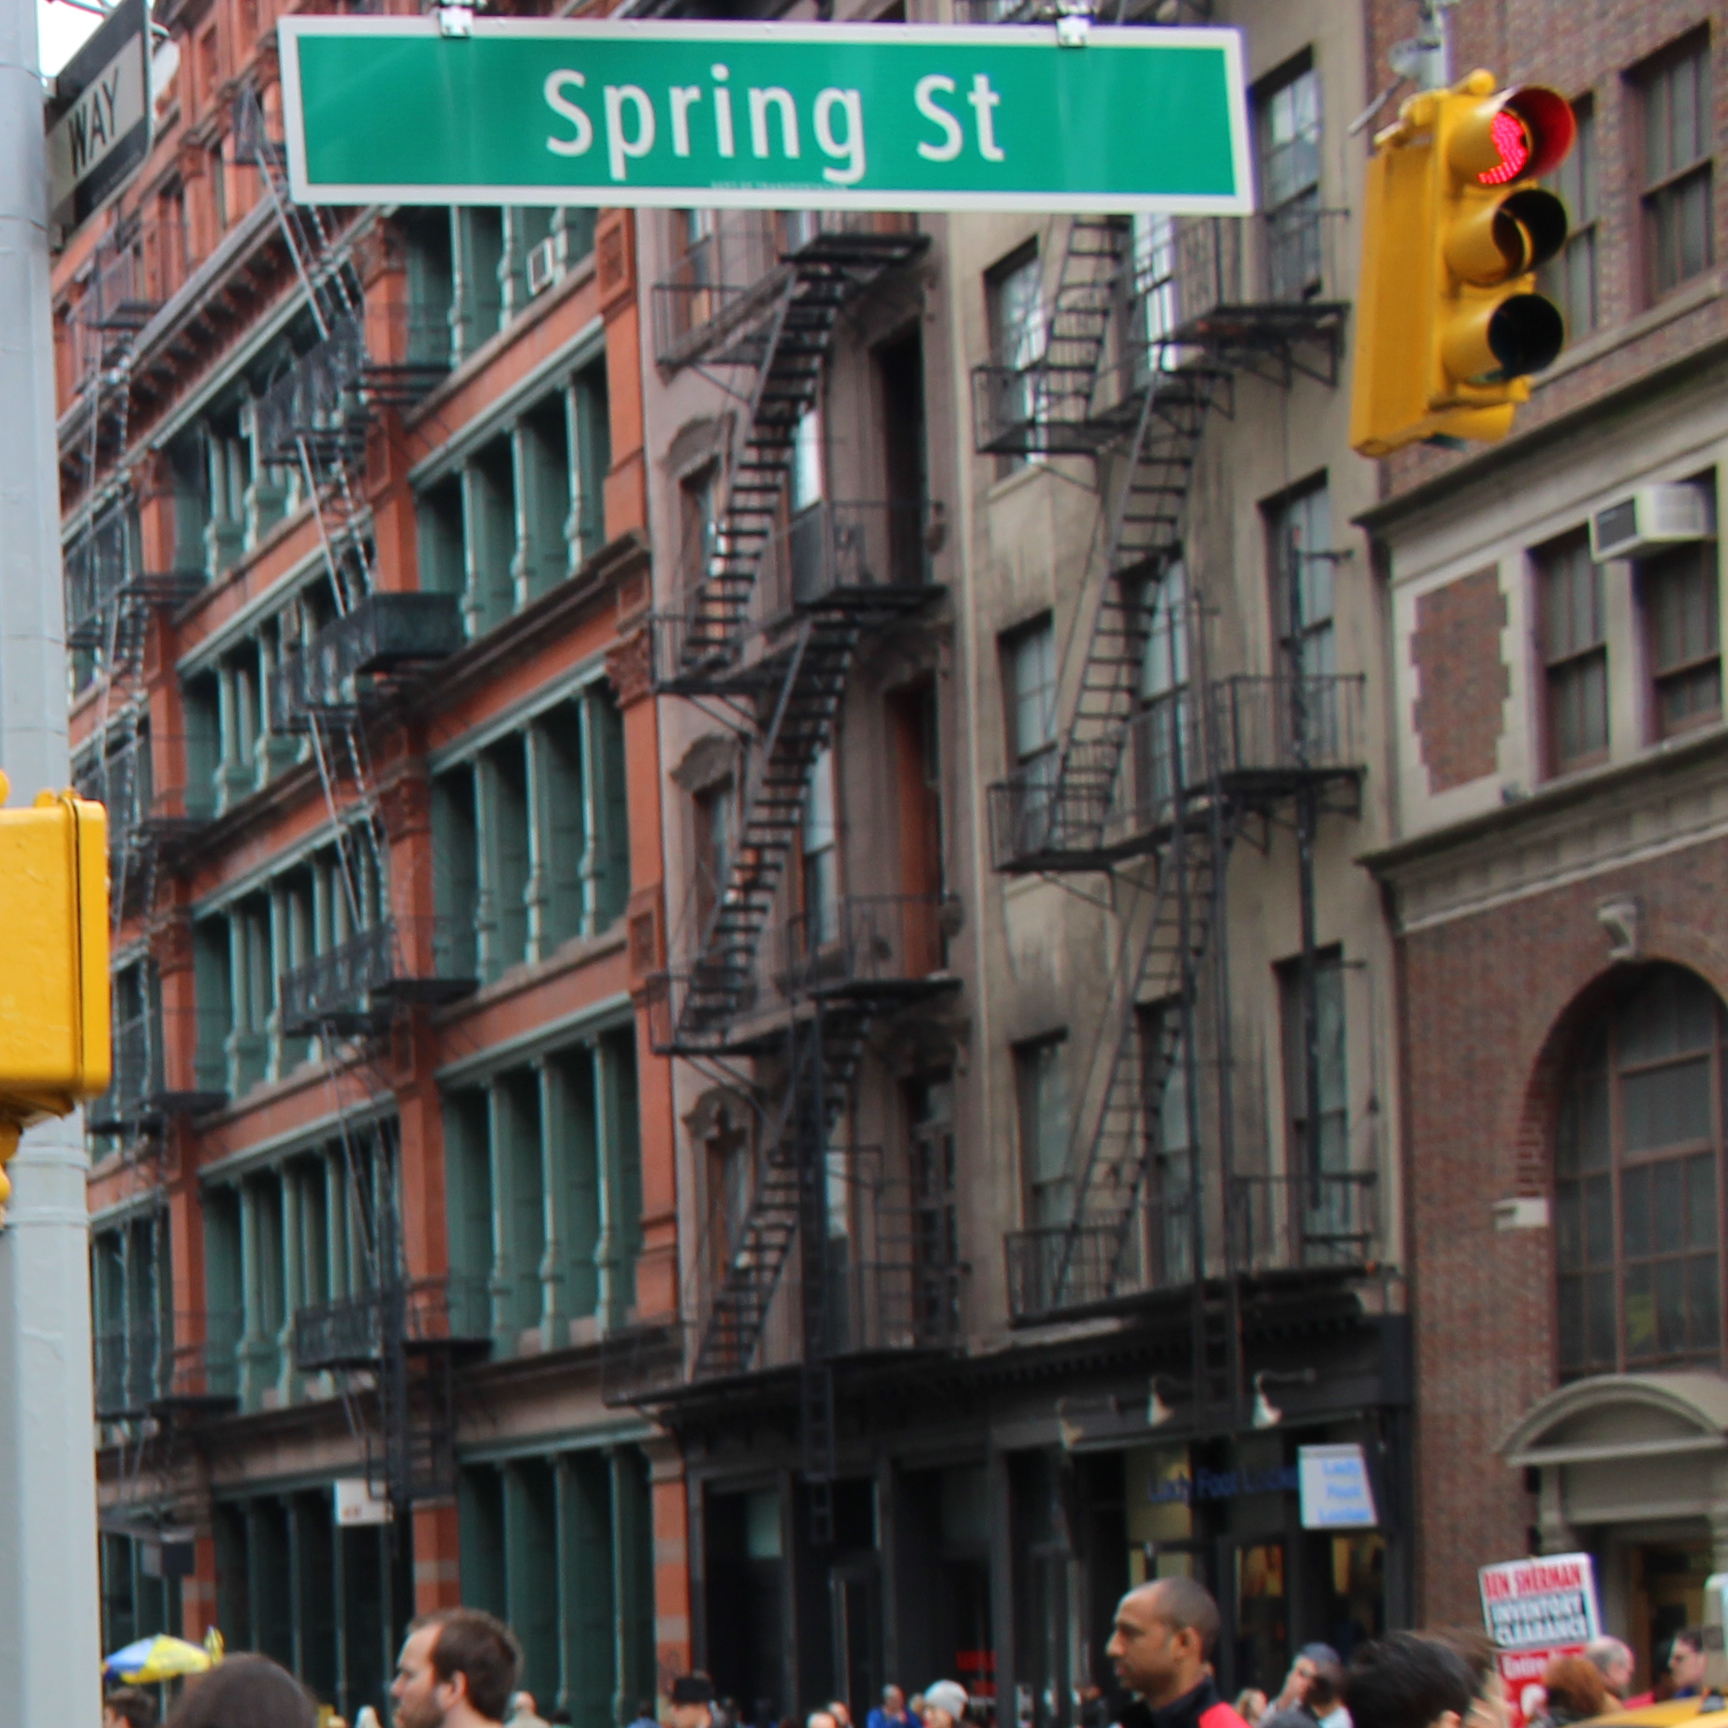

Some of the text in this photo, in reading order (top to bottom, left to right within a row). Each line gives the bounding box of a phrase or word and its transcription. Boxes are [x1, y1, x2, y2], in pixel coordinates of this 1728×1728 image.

[67, 64, 119, 178] WAY
[543, 64, 1006, 183] Spring St
[1485, 1563, 1581, 1598] BEN SHERMAN
